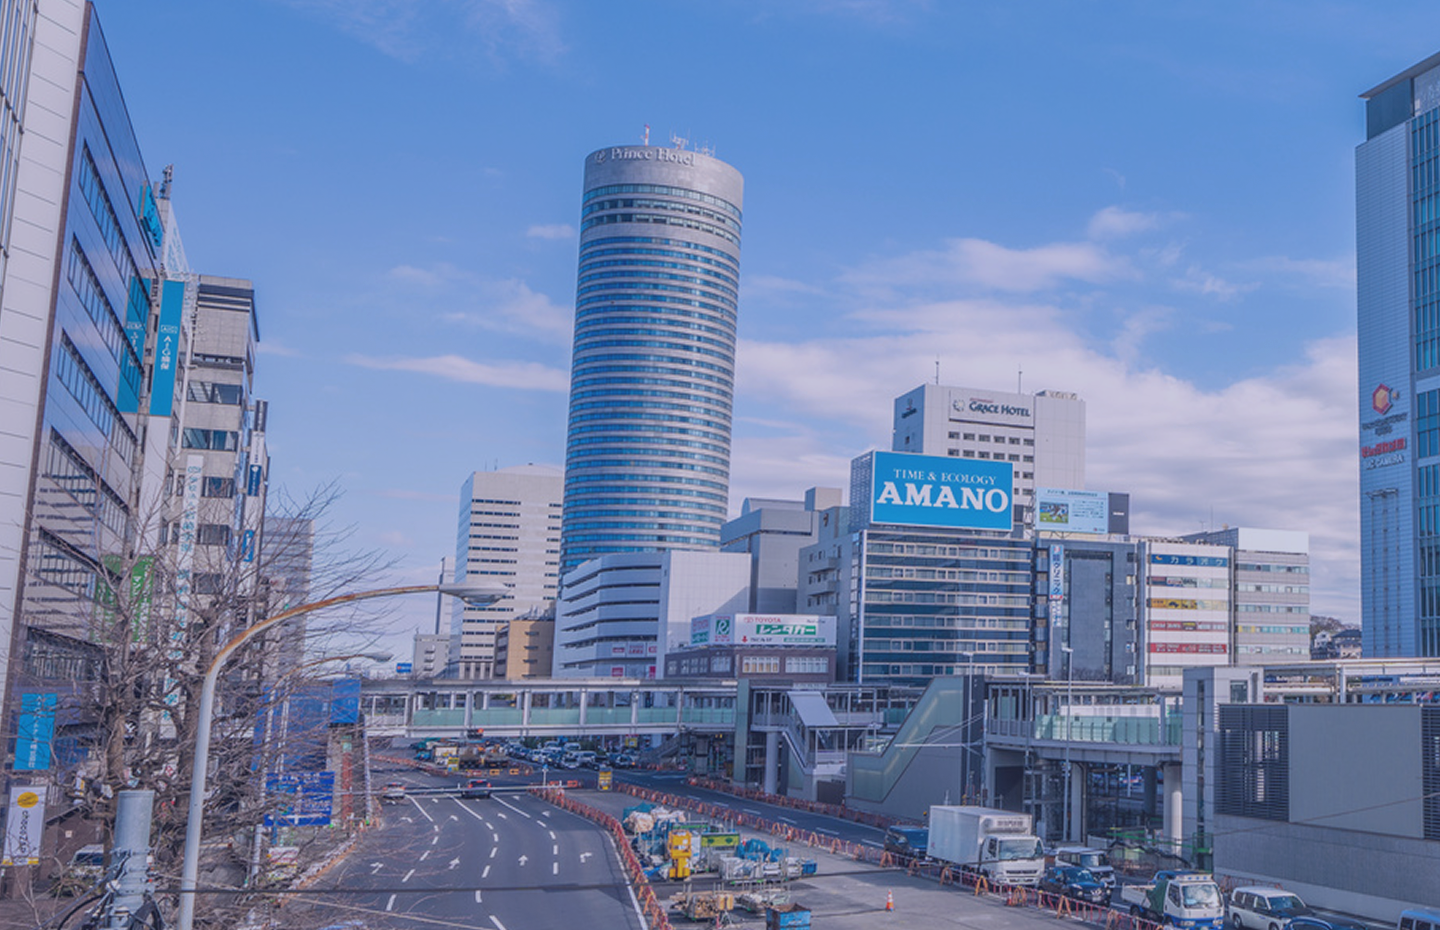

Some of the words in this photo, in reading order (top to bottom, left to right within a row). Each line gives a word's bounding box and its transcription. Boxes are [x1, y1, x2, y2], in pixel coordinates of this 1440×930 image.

[611, 147, 653, 160] Prince
[657, 148, 695, 167] Hotel
[969, 401, 999, 414] GRACE
[1001, 404, 1031, 417] HOTEL
[893, 468, 925, 480] TIME
[927, 471, 938, 482] &
[941, 472, 997, 485] ECOLOGY
[876, 481, 1009, 513] AMANO
[755, 616, 781, 624] TOYOTA
[759, 625, 816, 635] レンタカー
